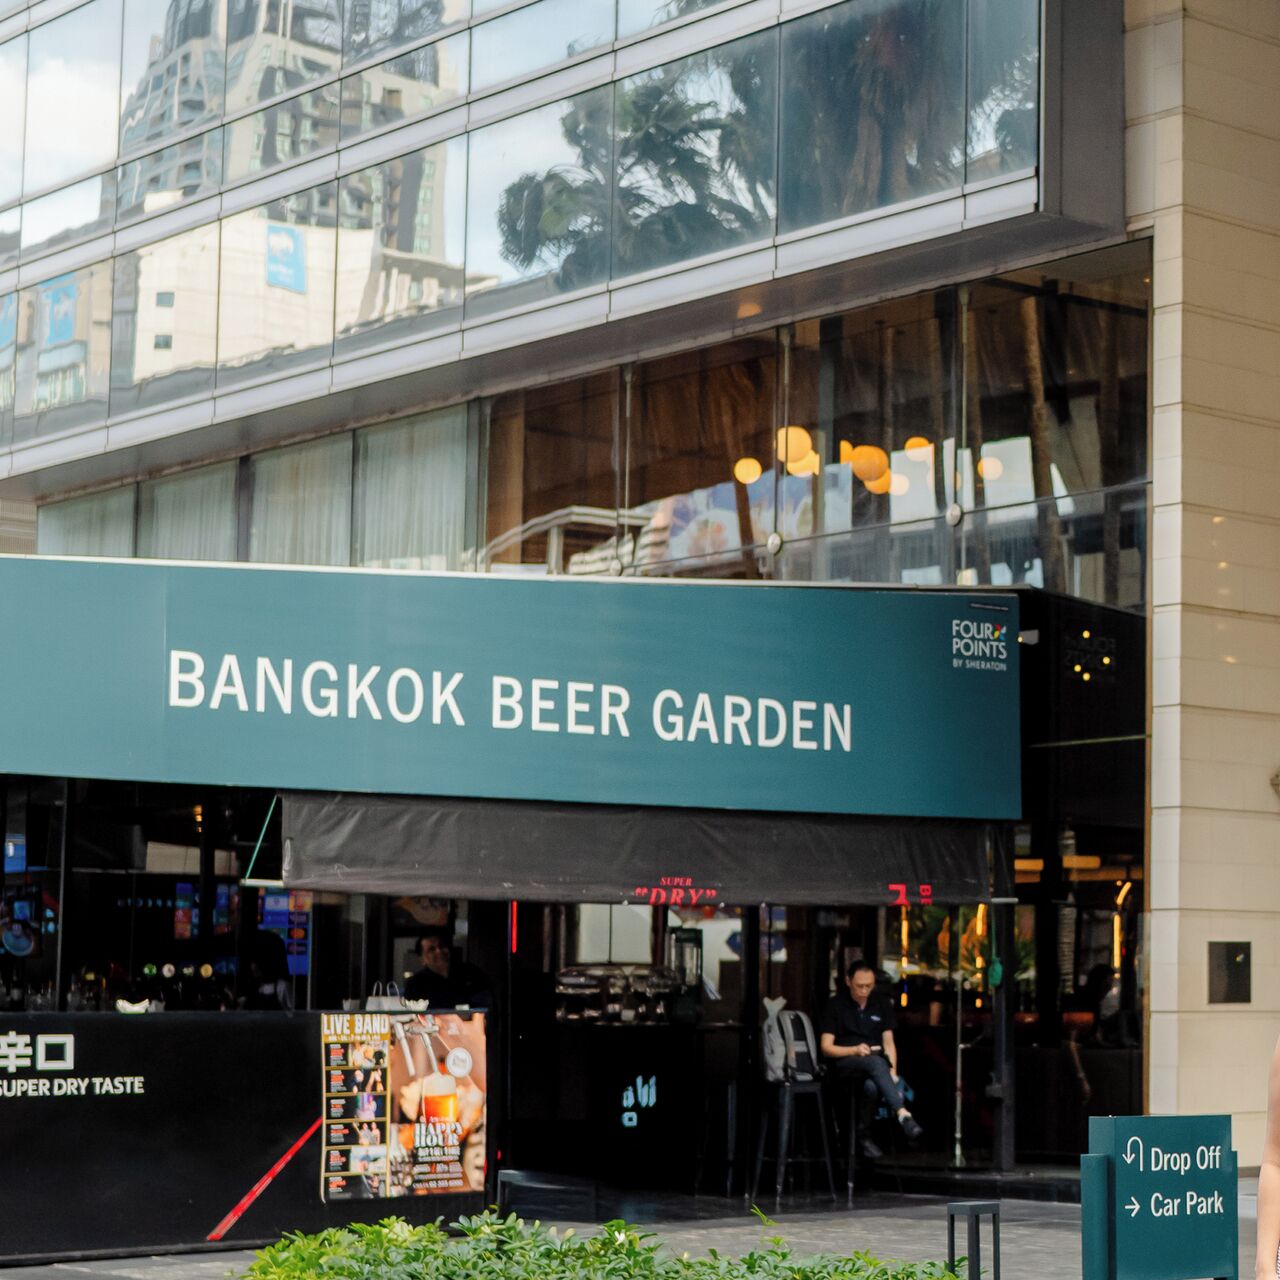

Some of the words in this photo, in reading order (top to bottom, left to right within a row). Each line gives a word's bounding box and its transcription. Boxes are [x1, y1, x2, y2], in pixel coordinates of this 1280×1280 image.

[952, 619, 994, 639] FOUR
[952, 638, 1008, 659] POINTS
[952, 658, 963, 668] BY
[966, 659, 1008, 672] SHERATON
[167, 648, 466, 727] BANGKOK
[490, 674, 632, 739] BEER
[652, 689, 853, 753] GARDEN
[659, 876, 692, 887] SUPER
[323, 1013, 350, 1034] LIVE
[354, 1013, 389, 1033] BAND
[0, 1078, 51, 1097] UPER
[53, 1077, 89, 1096] DRY
[92, 1076, 145, 1095] TASTE
[1151, 1147, 1191, 1176] Drop
[1196, 1145, 1222, 1170] Off
[1150, 1192, 1181, 1217] Car
[1186, 1190, 1224, 1216] Park
